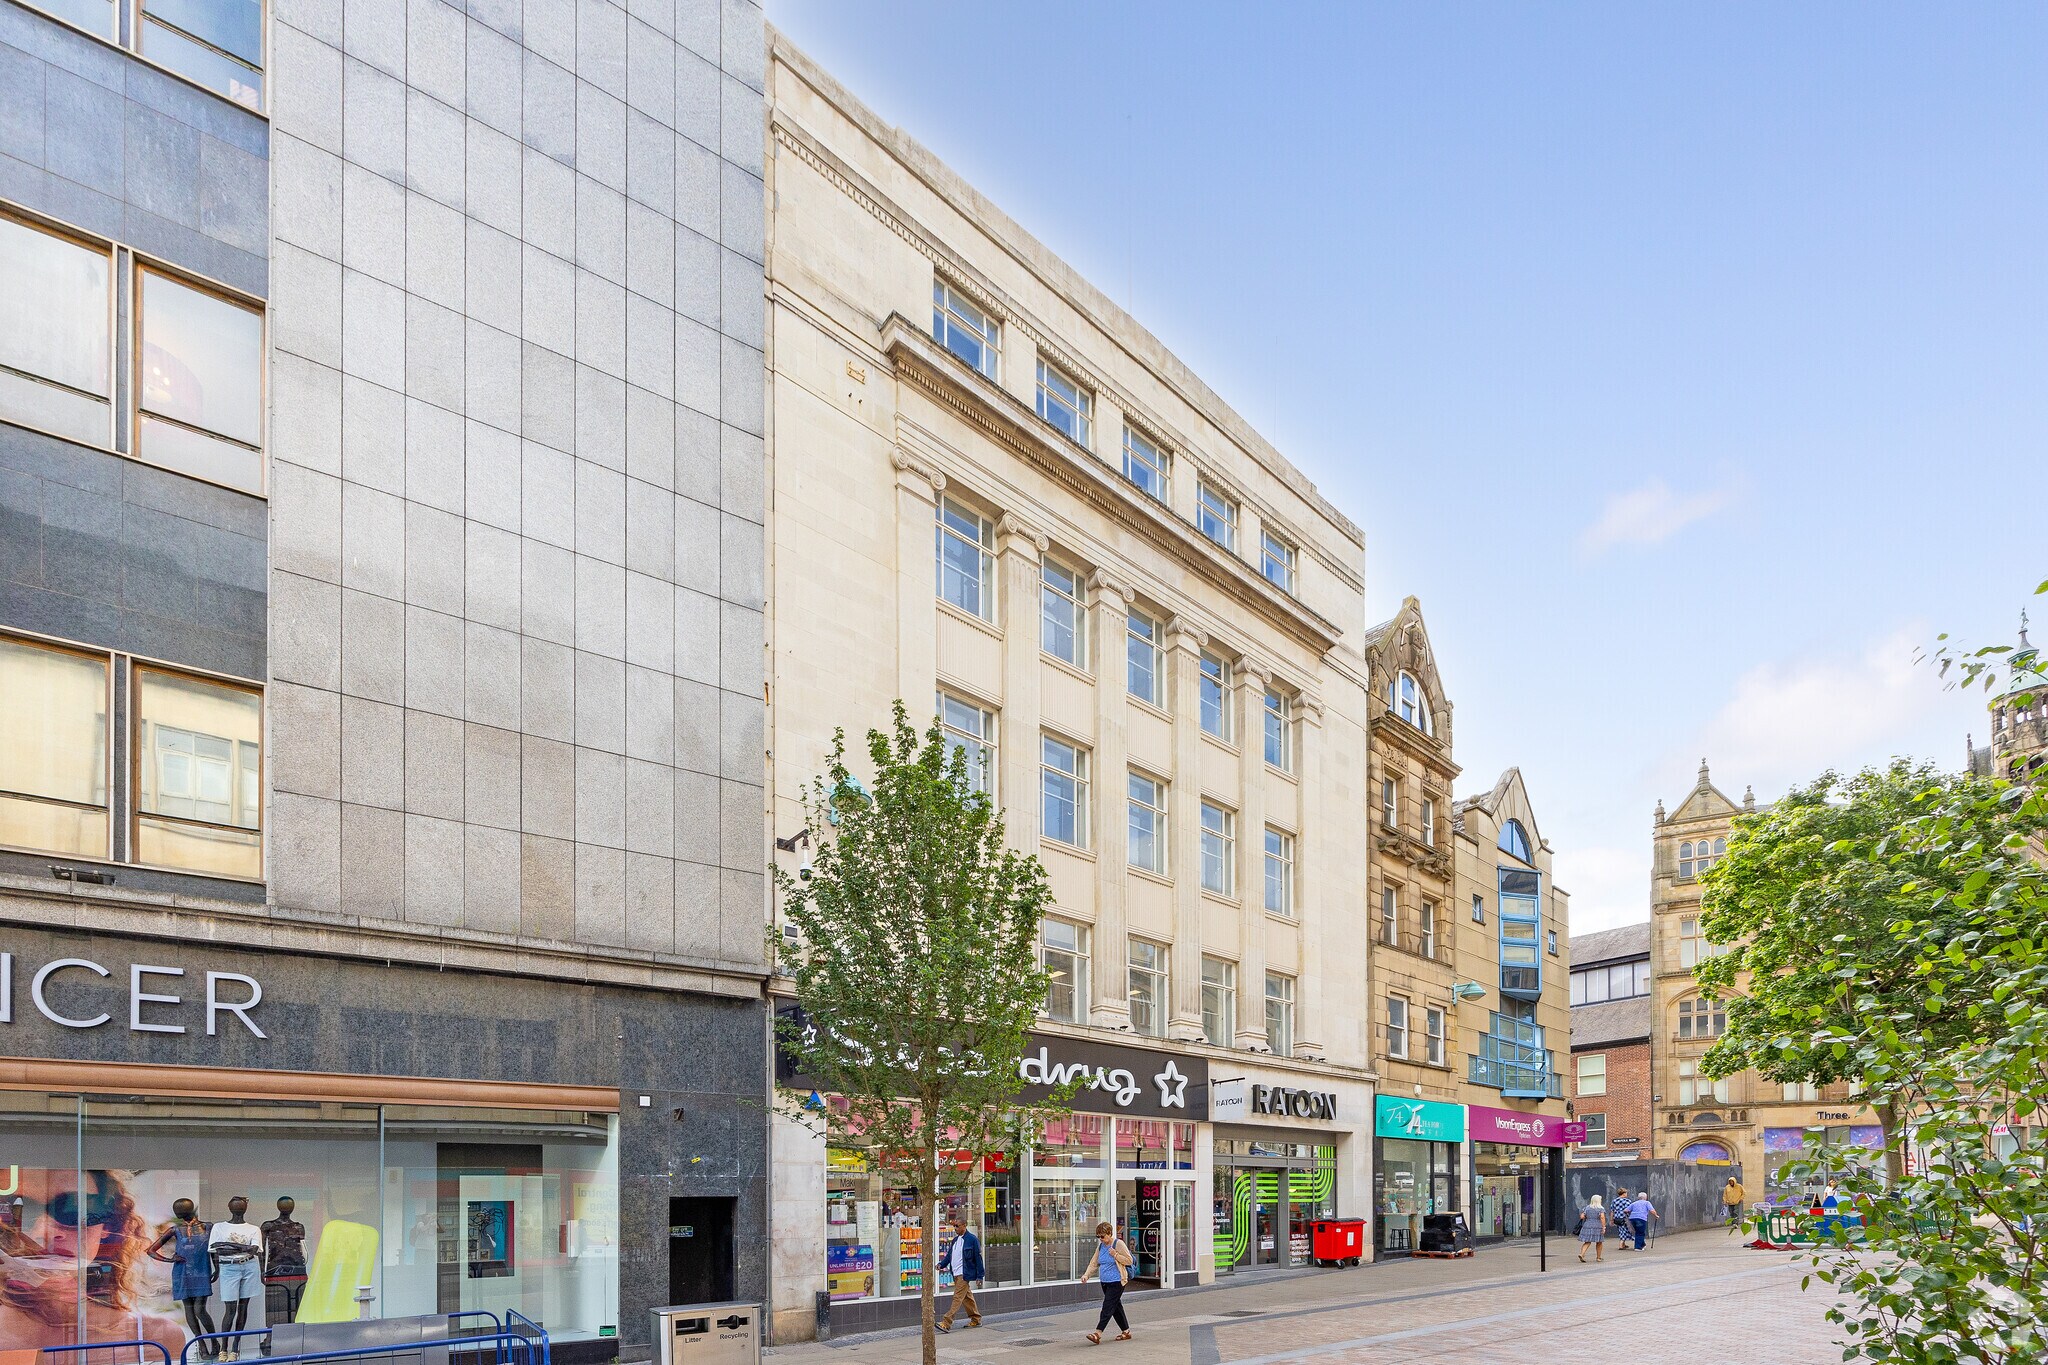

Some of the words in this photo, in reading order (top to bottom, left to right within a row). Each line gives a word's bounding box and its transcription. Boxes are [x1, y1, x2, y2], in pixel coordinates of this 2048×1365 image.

[1215, 1097, 1243, 1107] RATOON
[1252, 1083, 1337, 1120] RATOON
[855, 1261, 872, 1270] £20
[684, 1336, 702, 1344] Litter
[719, 1331, 748, 1340] Recycling
